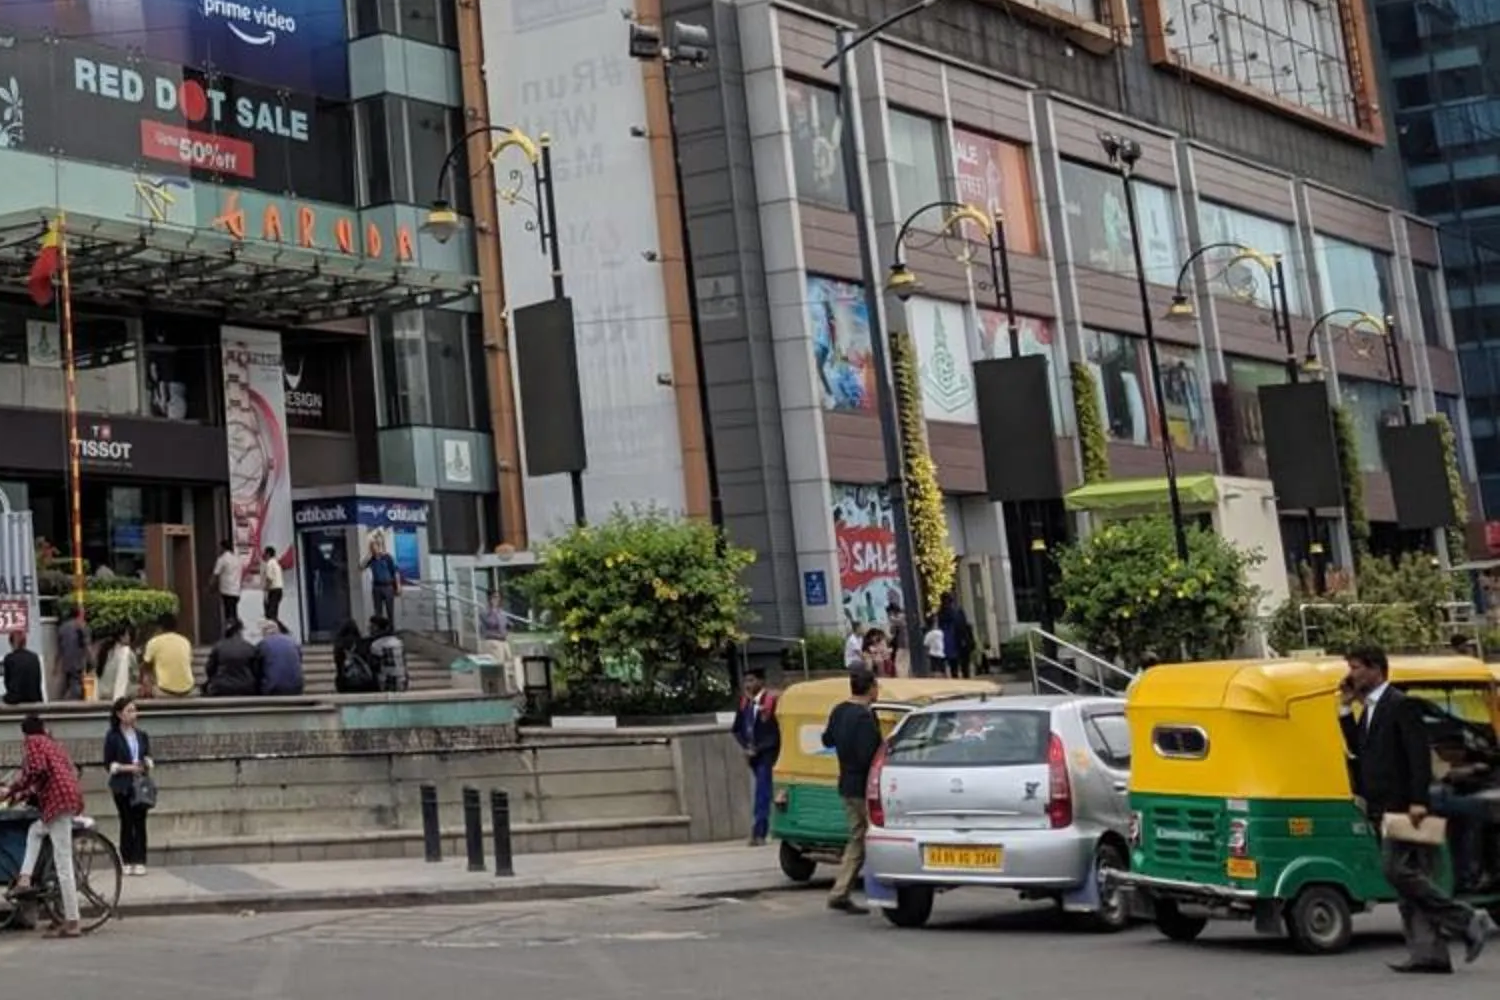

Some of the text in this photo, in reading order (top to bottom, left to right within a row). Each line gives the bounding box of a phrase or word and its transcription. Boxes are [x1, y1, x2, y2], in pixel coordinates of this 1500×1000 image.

[253, 4, 296, 32] video
[74, 57, 144, 103] RED
[236, 96, 309, 142] SALE
[69, 440, 133, 459] TISSOT
[295, 503, 348, 523] citibank
[851, 540, 899, 574] SALE
